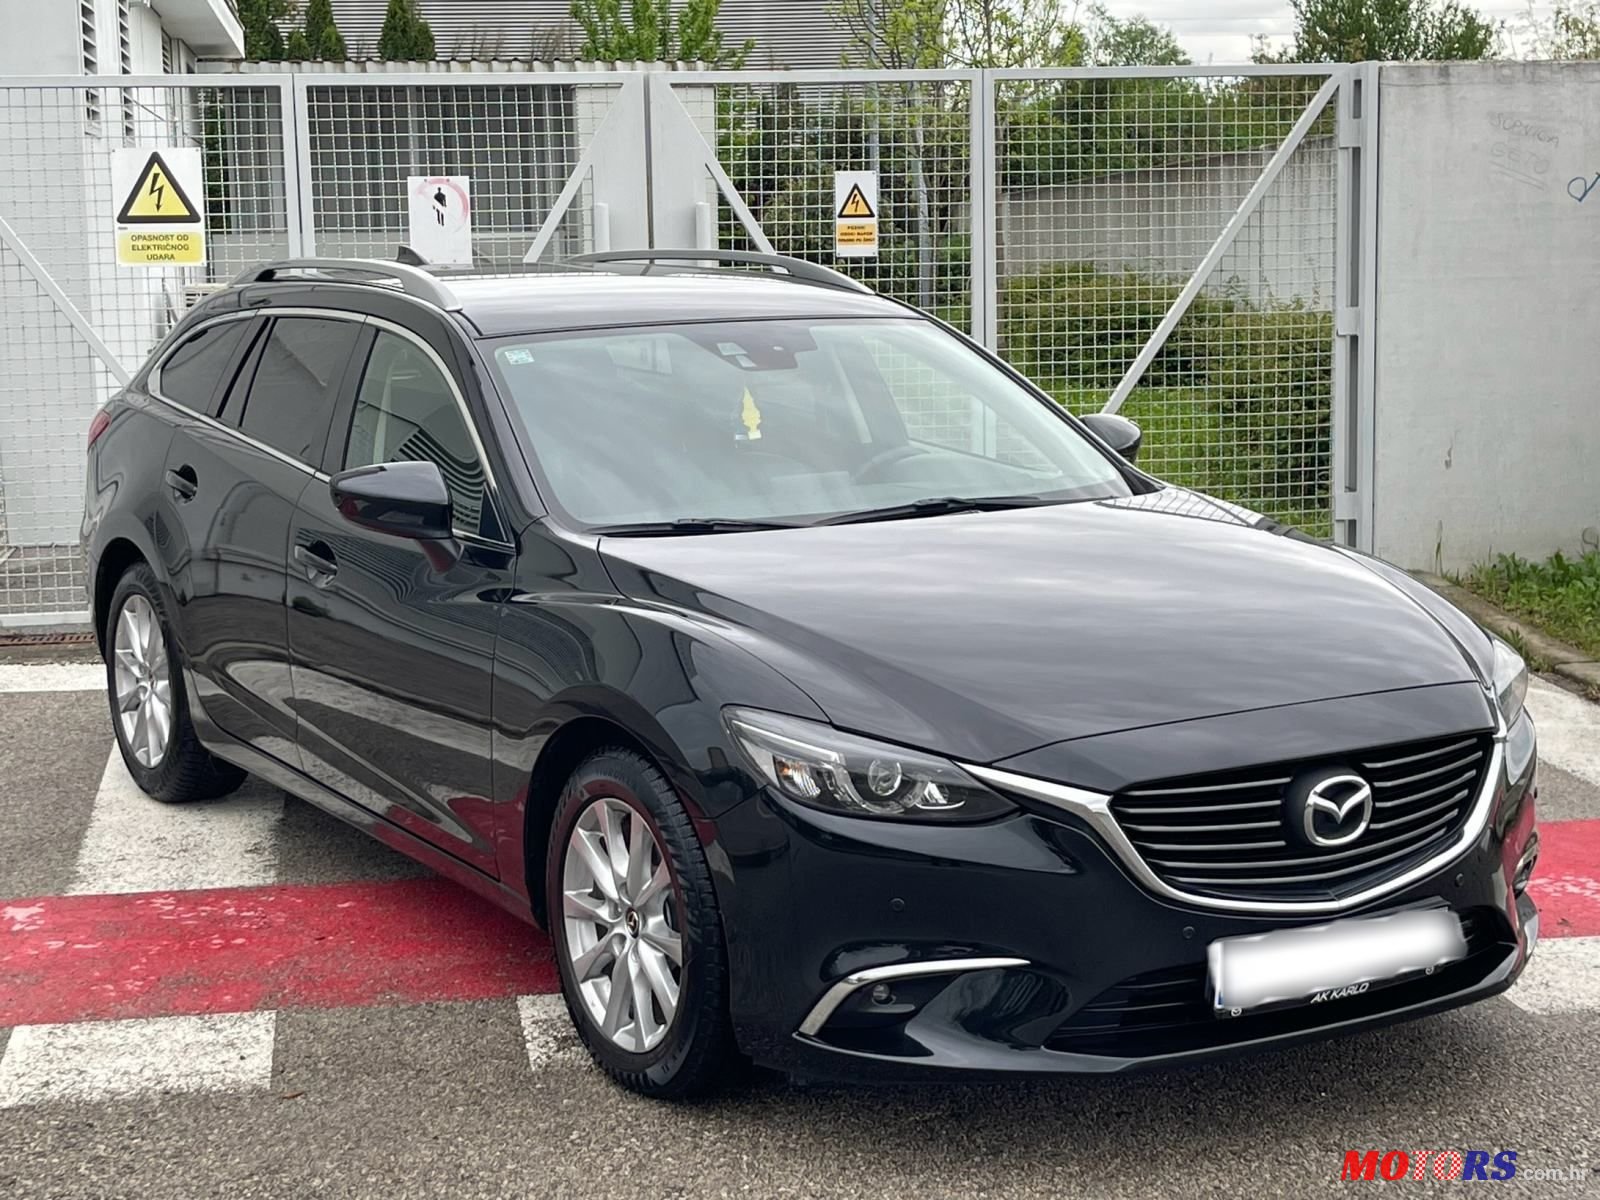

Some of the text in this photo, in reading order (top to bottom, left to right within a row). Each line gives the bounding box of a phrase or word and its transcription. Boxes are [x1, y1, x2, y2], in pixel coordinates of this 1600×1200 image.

[131, 234, 190, 242] OPASNOST OD
[131, 243, 190, 251] ELEKTRIČNOG
[146, 253, 176, 261] UDARA
[1310, 982, 1370, 1004] AK KARLO
